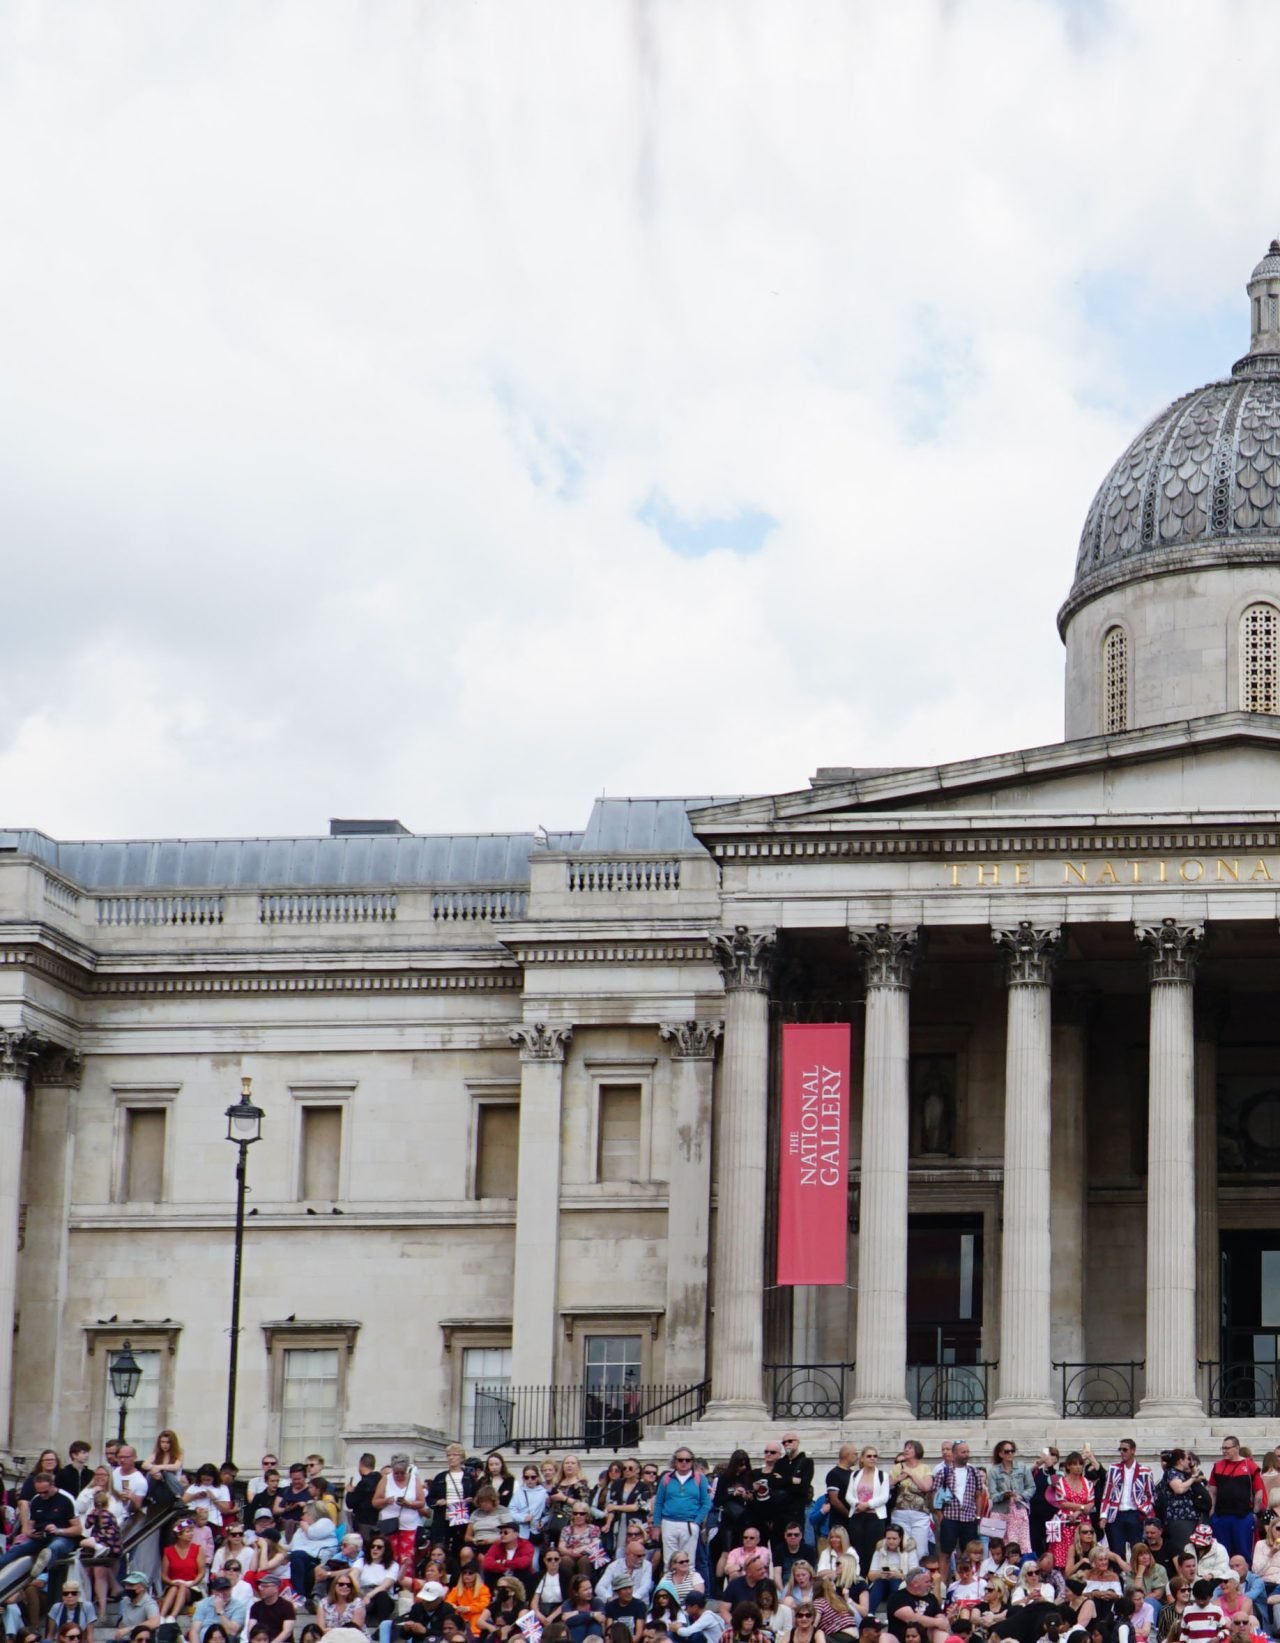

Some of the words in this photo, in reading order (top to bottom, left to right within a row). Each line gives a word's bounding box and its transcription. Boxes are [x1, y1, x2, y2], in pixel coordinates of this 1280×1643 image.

[943, 861, 1031, 886] THE
[789, 1131, 799, 1155] THE
[800, 1065, 819, 1185] NATIONAL
[819, 1065, 841, 1186] GALLERY
